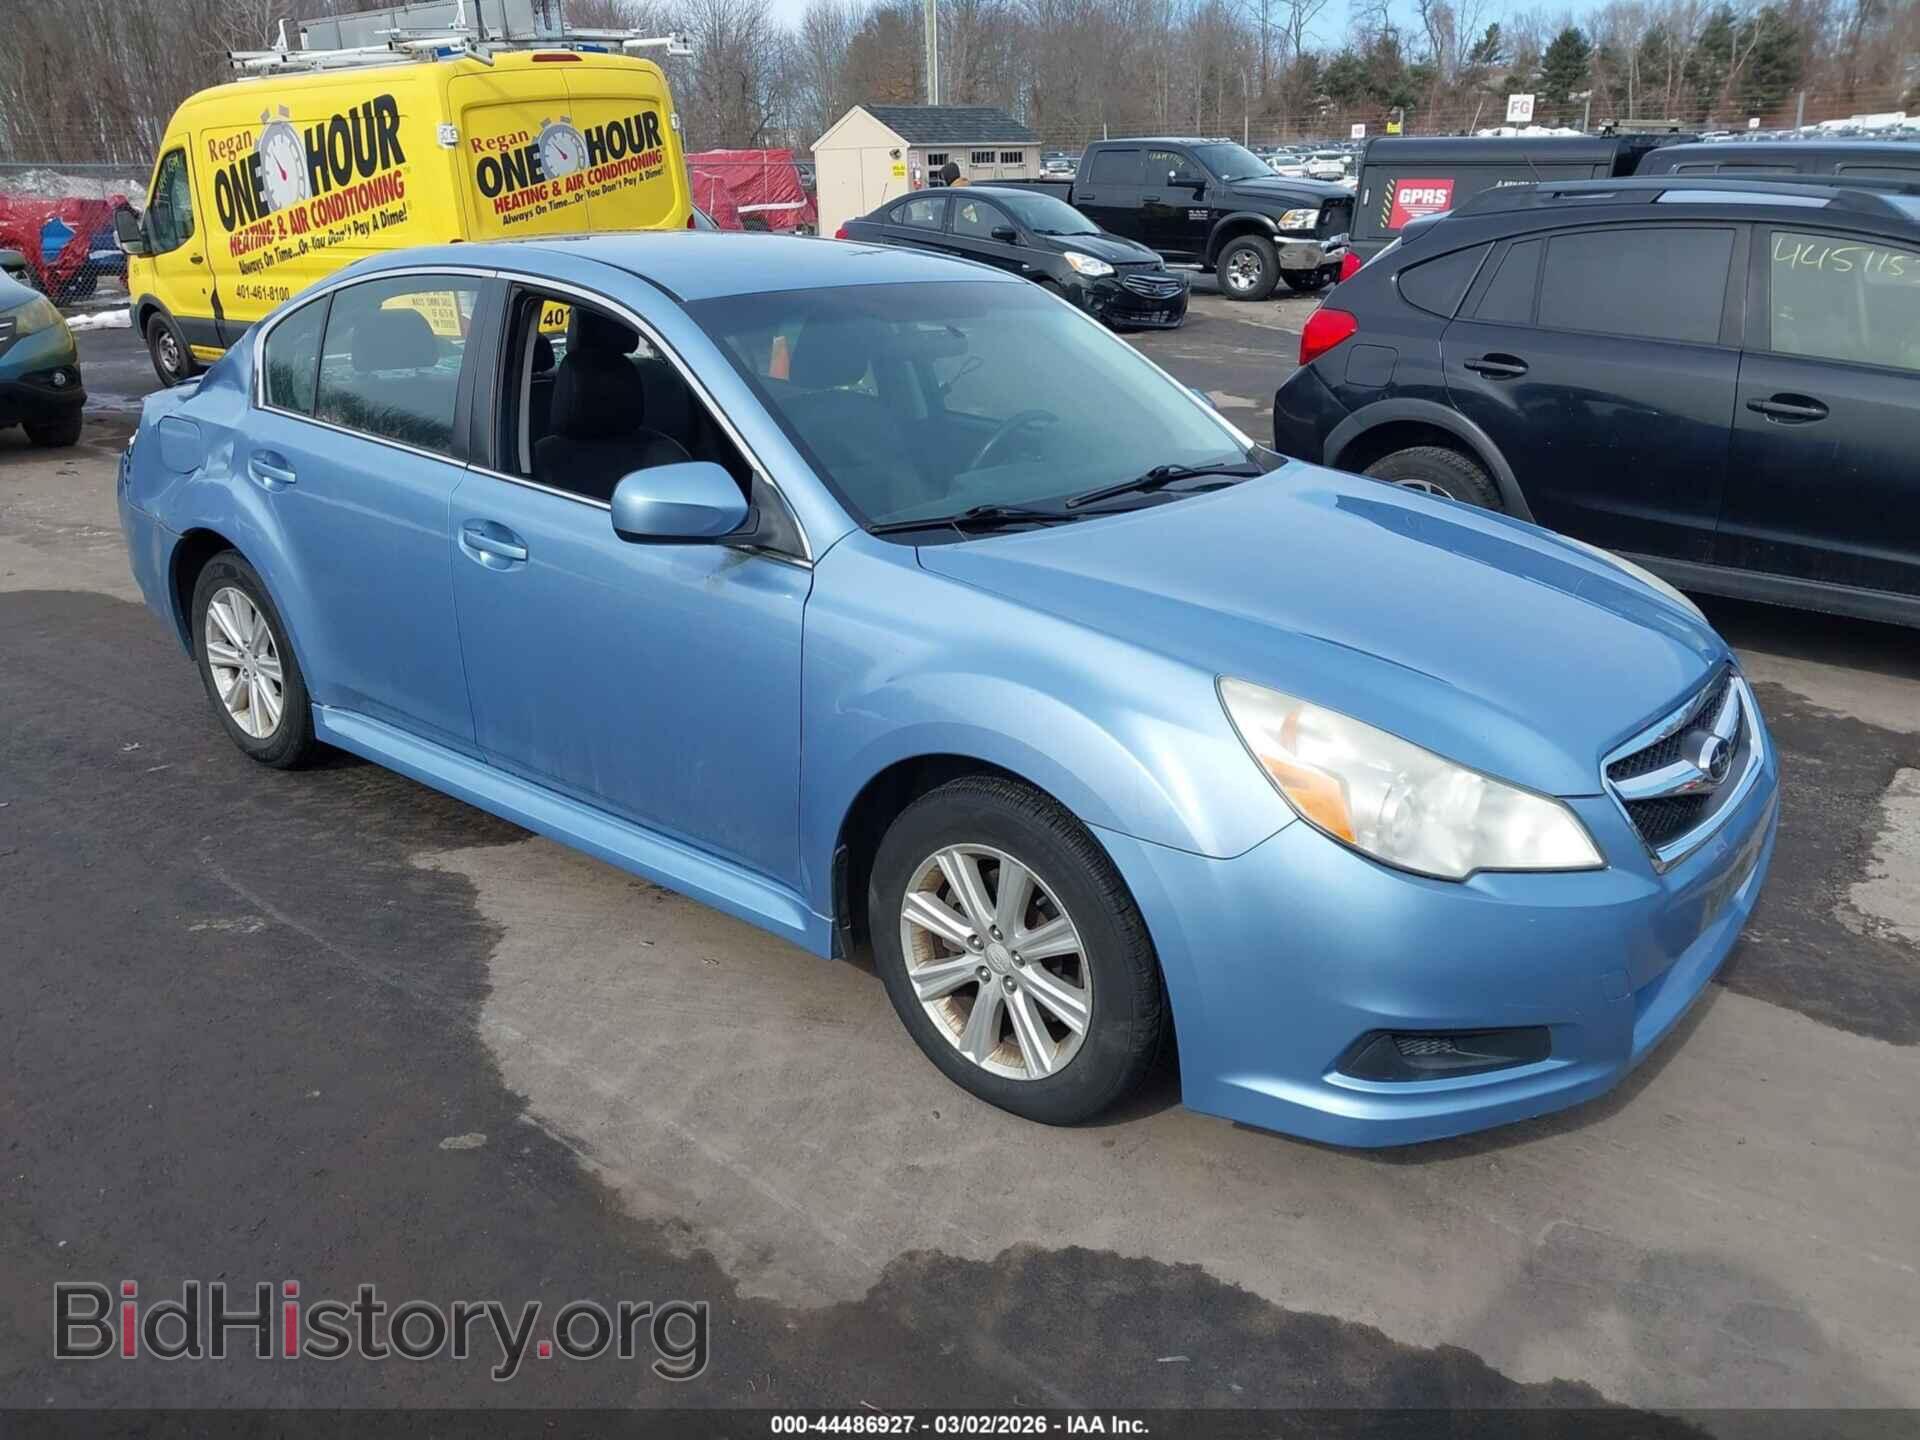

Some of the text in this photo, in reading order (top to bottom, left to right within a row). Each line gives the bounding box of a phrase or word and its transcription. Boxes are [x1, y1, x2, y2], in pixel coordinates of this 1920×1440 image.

[1510, 101, 1530, 114] FG
[208, 131, 253, 162] Regan
[214, 151, 271, 232] ONE
[304, 93, 406, 197] HOUR
[470, 130, 529, 154] Regan
[476, 110, 663, 198] ONE HOUR
[494, 149, 663, 214] HEATING & AIR CONDITIONING
[503, 209, 533, 225] Always
[535, 204, 547, 215] On
[586, 189, 600, 198] You
[602, 180, 622, 194] Don't
[624, 176, 637, 188] Pay
[639, 172, 645, 180] A
[1399, 188, 1448, 204] GPRS
[229, 169, 405, 258] HEATING & AIR CONDITIONING
[239, 258, 264, 275] Always
[263, 252, 275, 266] On
[311, 235, 325, 250] You
[328, 223, 352, 246] Don't
[353, 220, 370, 239] Pay
[372, 213, 380, 232] A
[380, 202, 408, 229] Dime!
[236, 285, 290, 301] 401-461-8100
